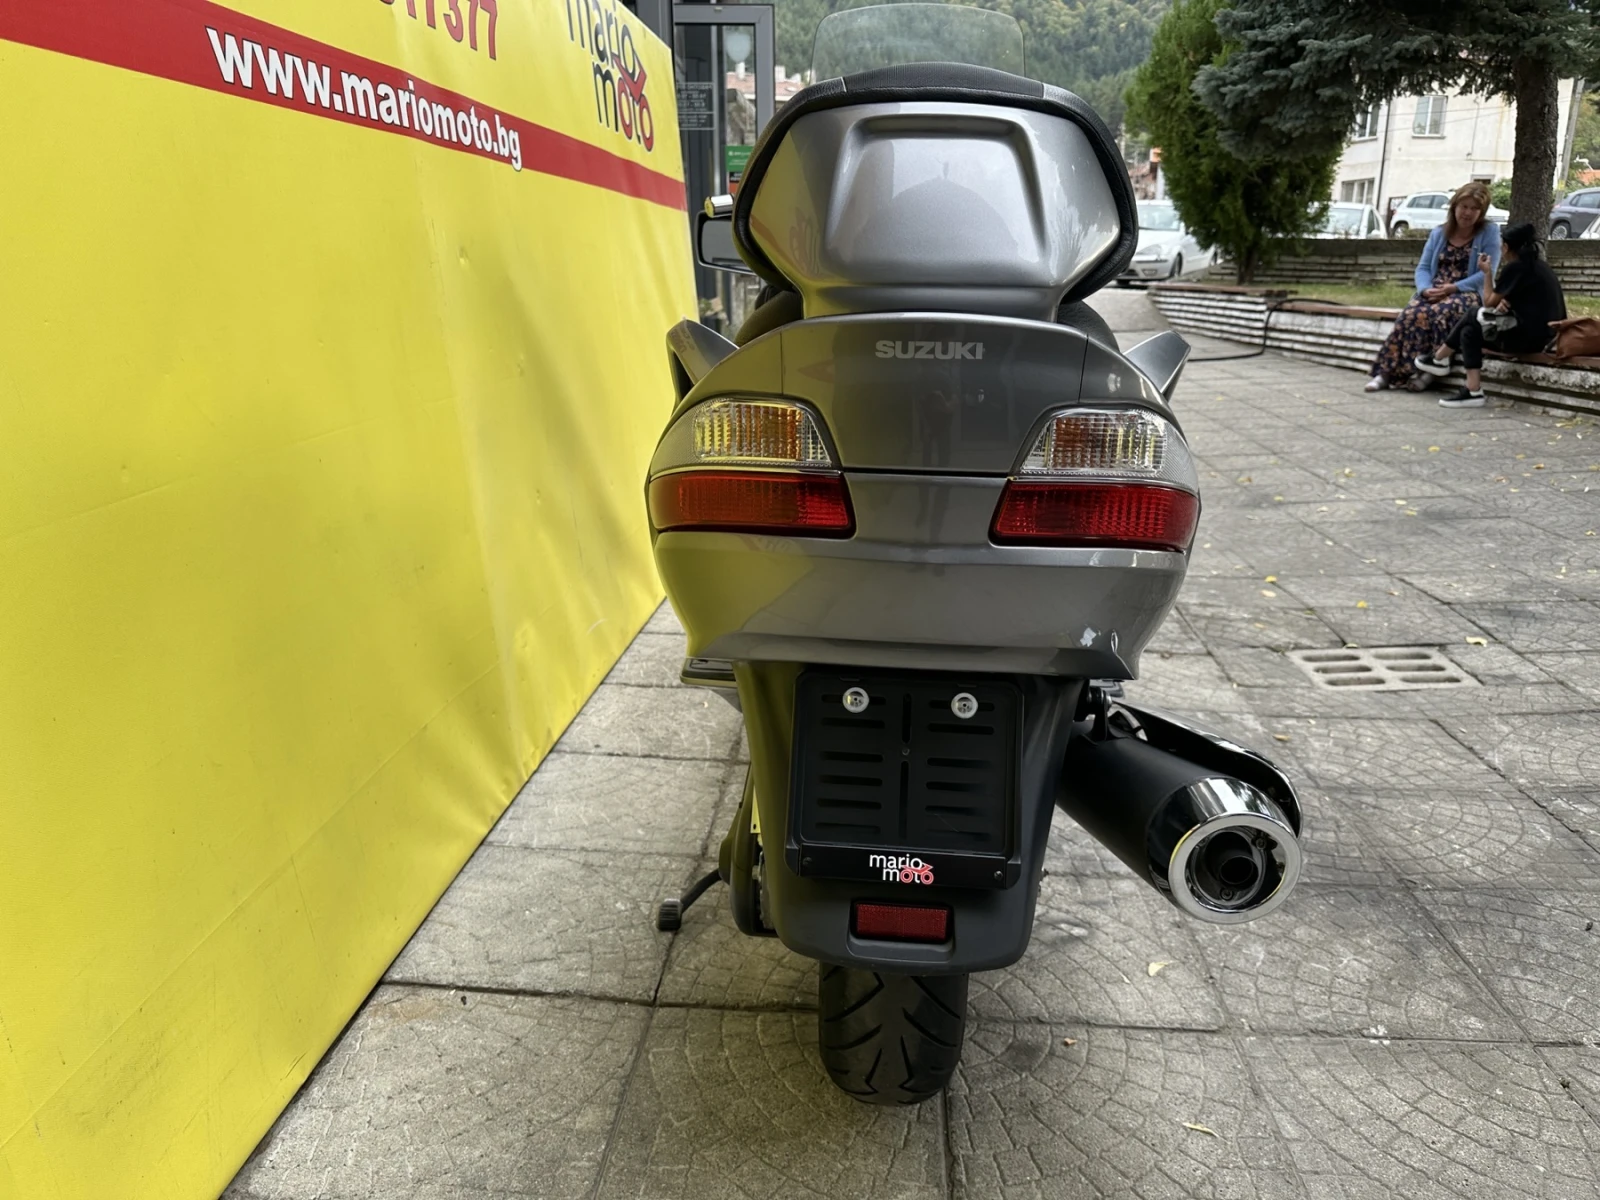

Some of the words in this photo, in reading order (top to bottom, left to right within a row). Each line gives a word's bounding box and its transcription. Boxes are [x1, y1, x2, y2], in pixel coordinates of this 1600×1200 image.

[206, 26, 523, 172] www.mariomoto.bg
[592, 61, 654, 152] moto
[874, 339, 984, 360] SUZUKI
[869, 853, 923, 869] mario
[882, 868, 934, 885] moto
